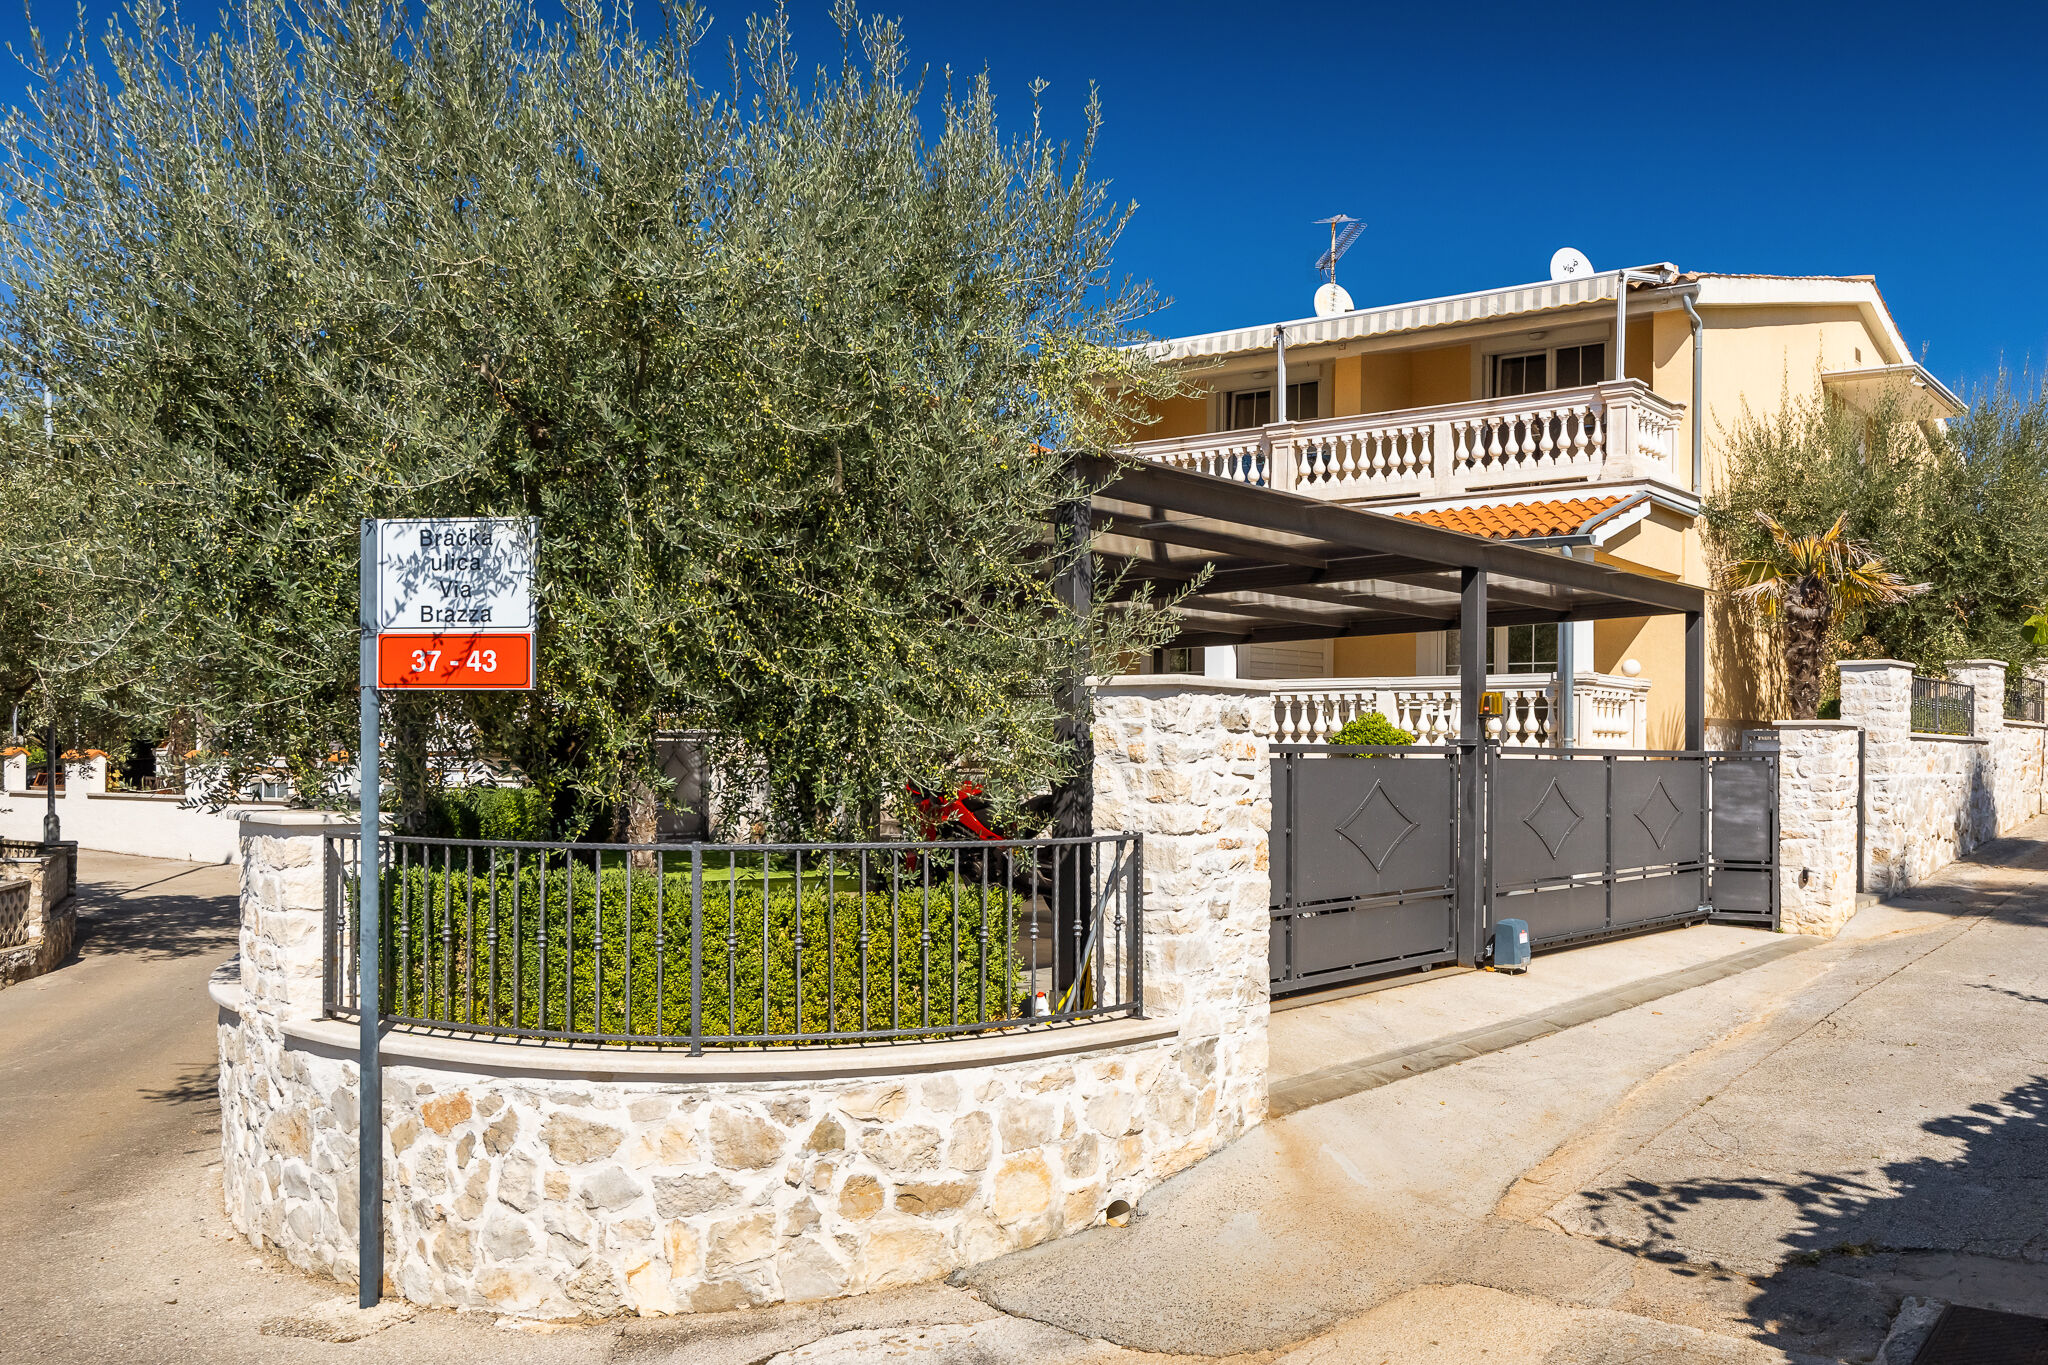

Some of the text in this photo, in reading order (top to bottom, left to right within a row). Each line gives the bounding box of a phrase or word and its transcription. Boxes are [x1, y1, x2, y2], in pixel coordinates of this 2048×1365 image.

[419, 527, 493, 547] Bračka
[431, 553, 481, 571] ulica
[440, 580, 472, 598] Via
[420, 605, 492, 623] Brazza
[411, 650, 442, 672] 37
[466, 649, 497, 672] 43
